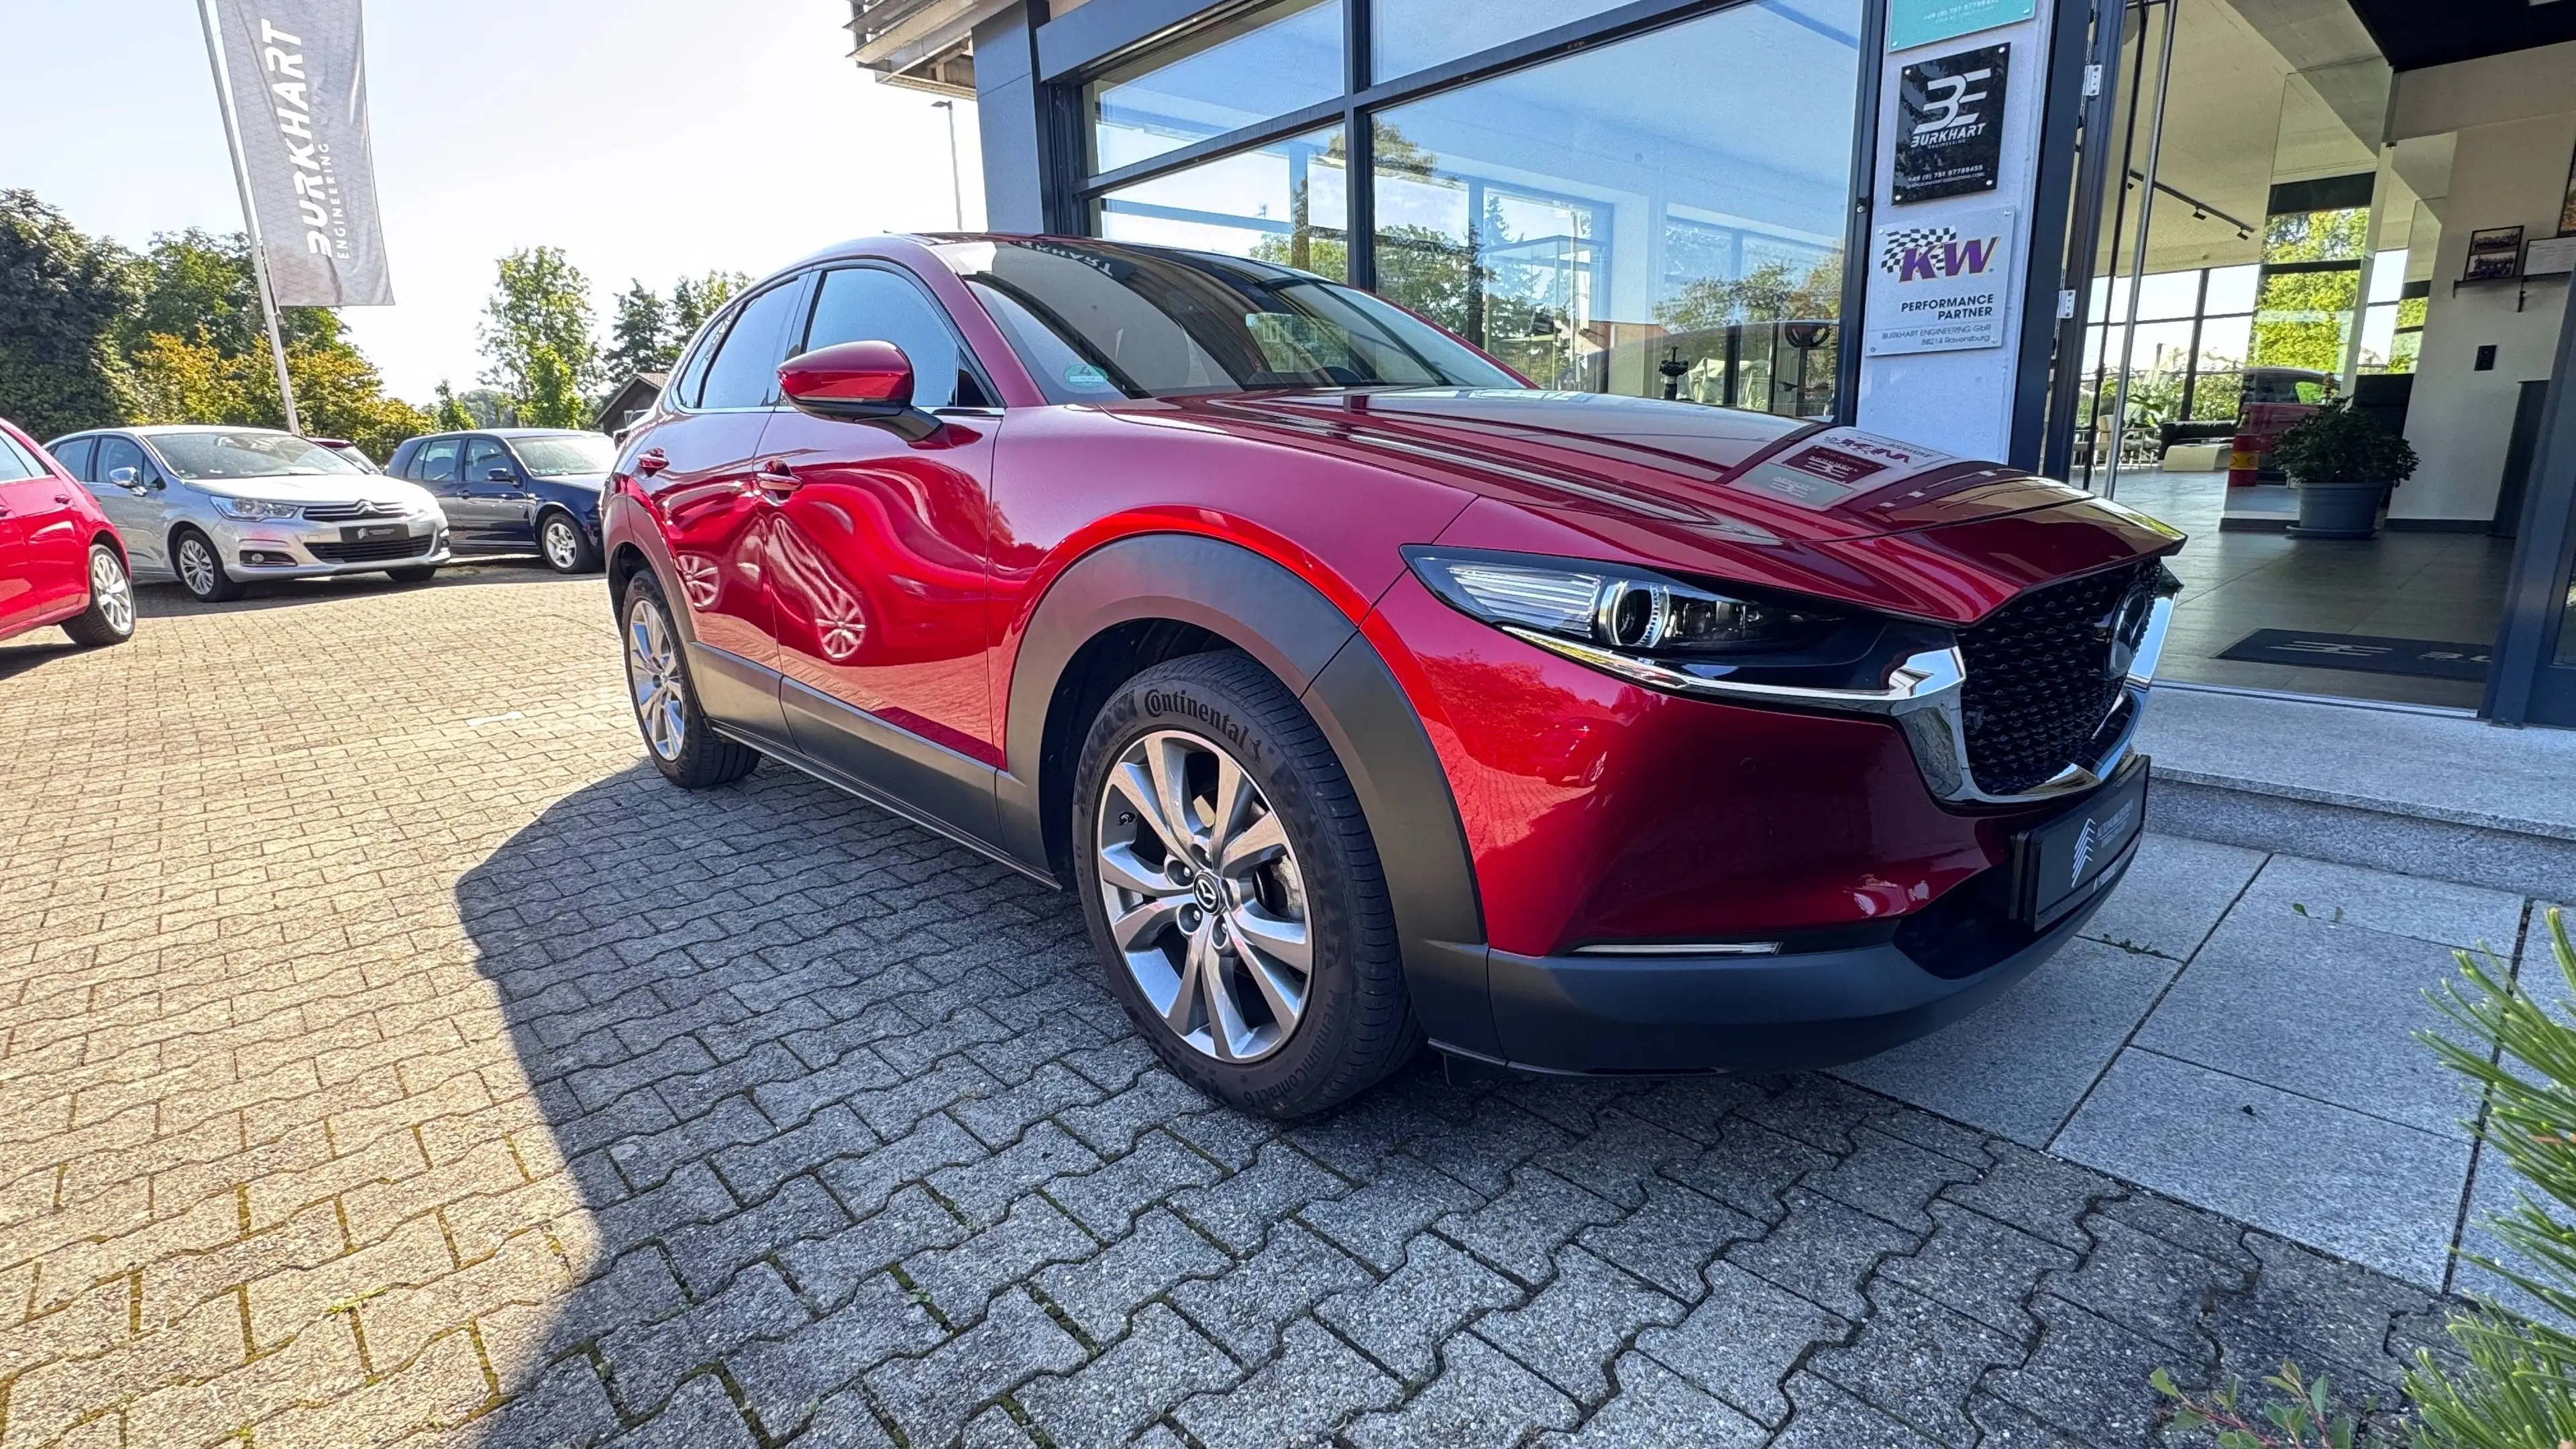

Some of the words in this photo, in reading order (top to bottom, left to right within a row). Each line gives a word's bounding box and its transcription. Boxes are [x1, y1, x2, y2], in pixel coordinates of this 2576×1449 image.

[261, 18, 332, 258] BURKHART
[1909, 123, 1986, 148] BURKHART
[317, 142, 350, 260] ENGINEERING
[1898, 236, 2000, 282] KW
[1900, 294, 1994, 312] PERFORMANCE
[1937, 307, 1993, 321] PARTNER
[1882, 330, 1919, 339] BURKHART
[1920, 326, 1972, 337] ENGINEERING
[1144, 689, 1250, 751] Continental
